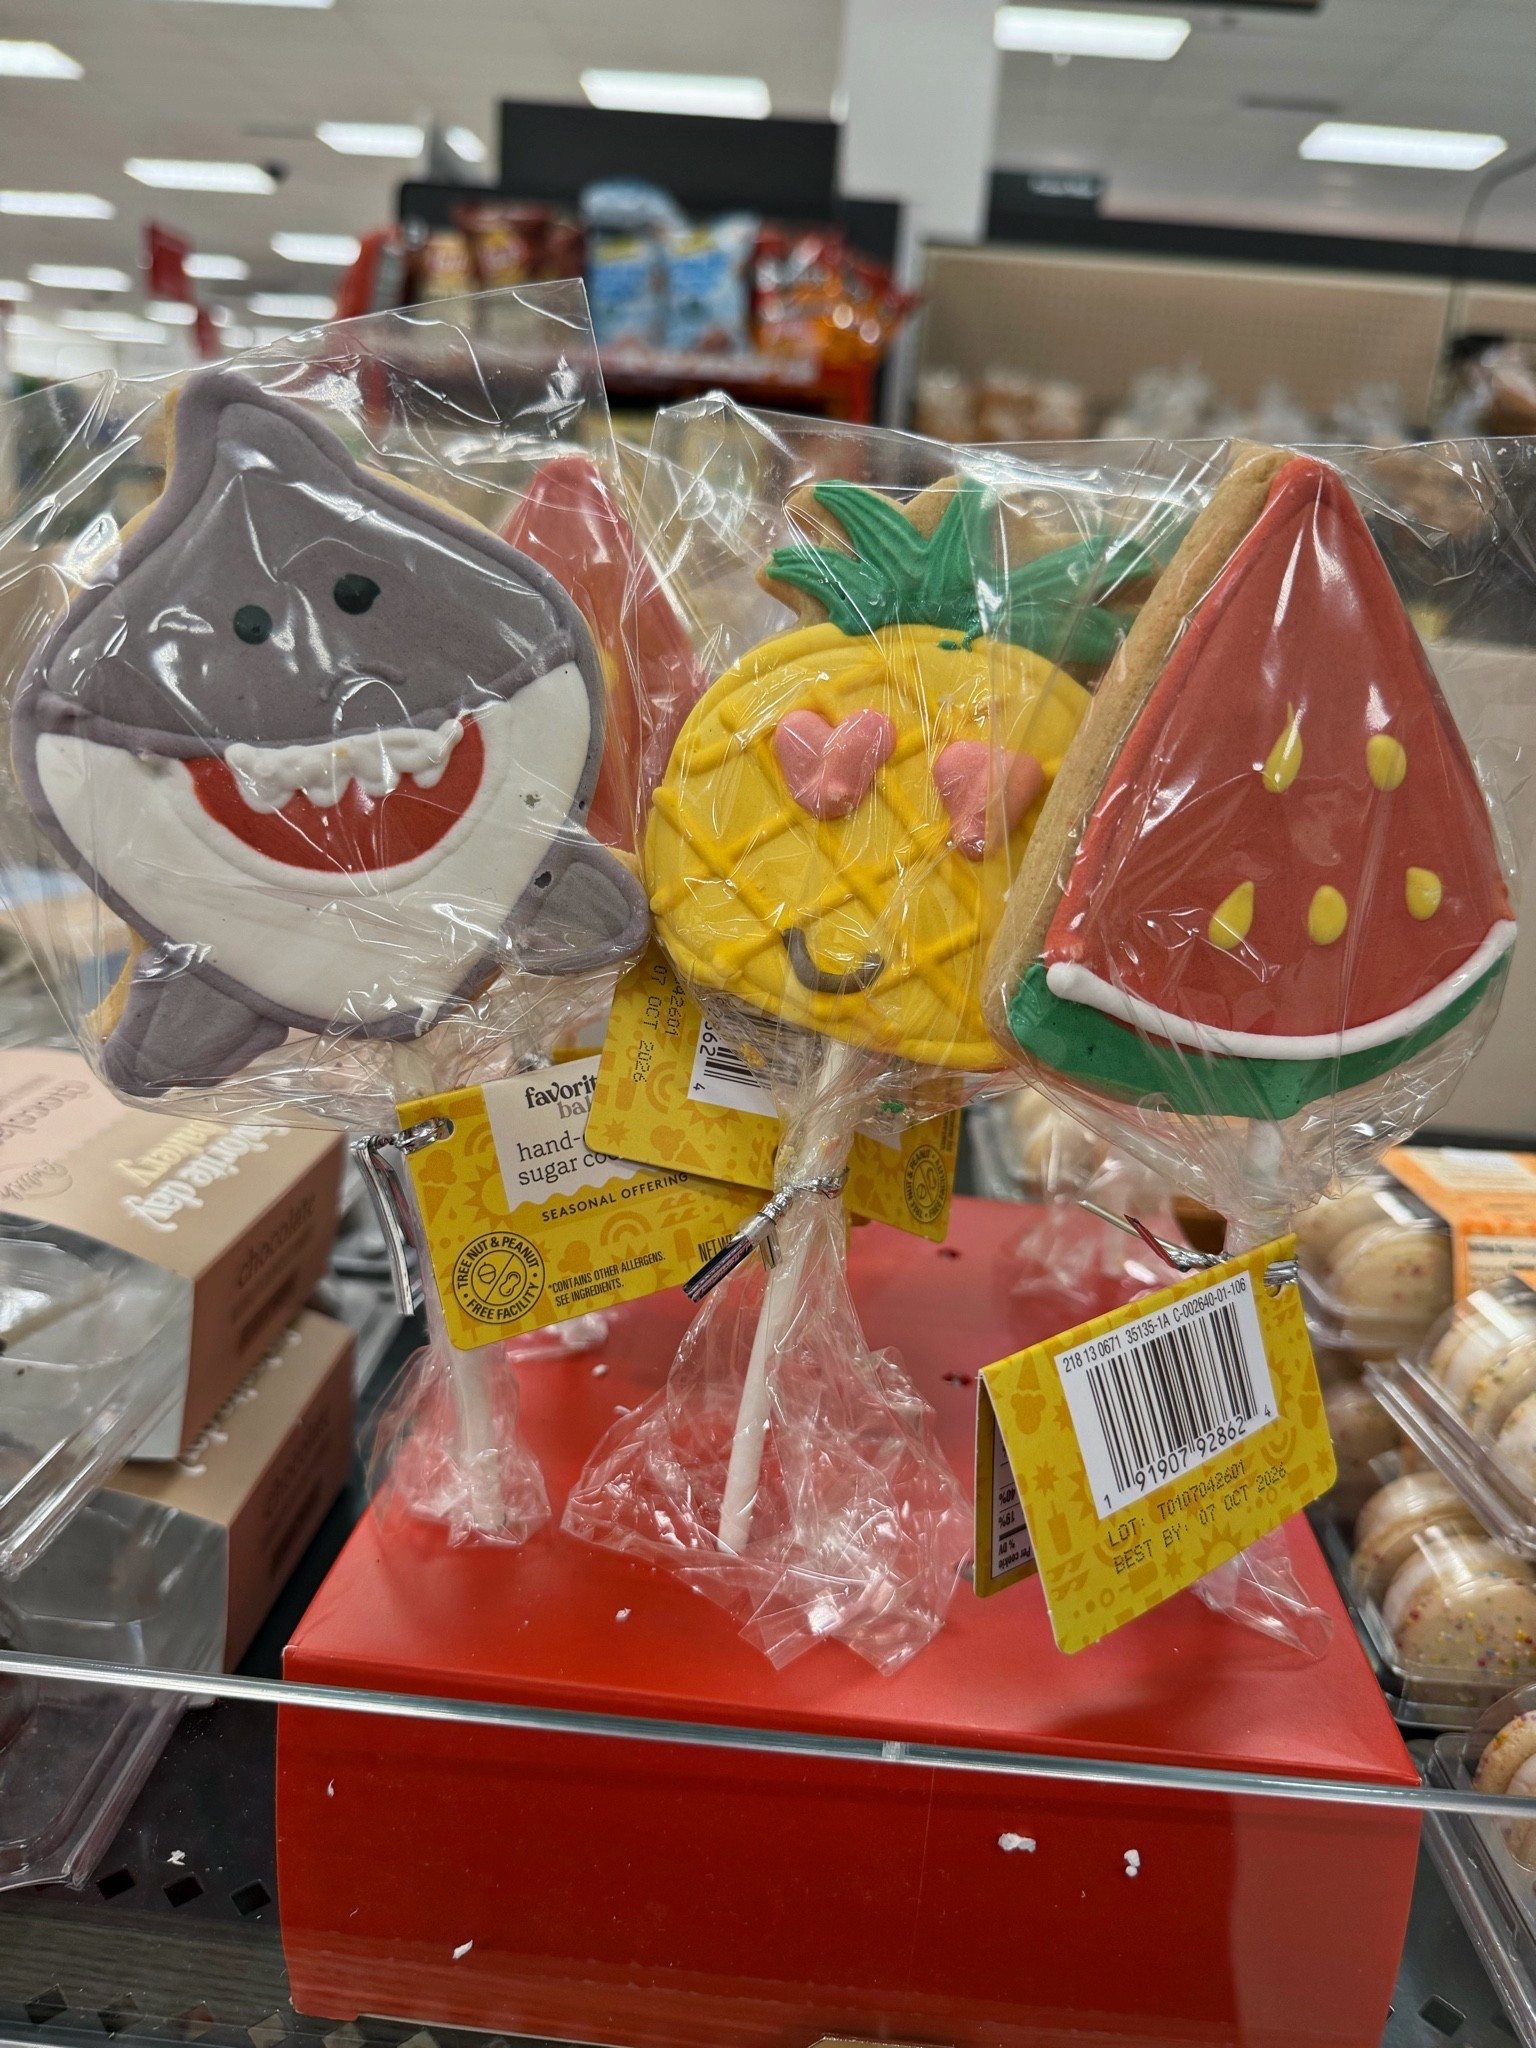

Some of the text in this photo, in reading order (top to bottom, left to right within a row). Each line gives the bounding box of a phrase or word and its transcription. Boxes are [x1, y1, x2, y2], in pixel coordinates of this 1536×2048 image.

[633, 965, 668, 1083] 07 OCT 2026
[524, 1074, 598, 1109] favorit
[693, 1082, 706, 1091] 4
[516, 1130, 586, 1162] hand-
[518, 1157, 578, 1186] sugar
[541, 1172, 688, 1222] SEASONAL OFFERING
[457, 1236, 540, 1290] TREE NUT & PEANUT
[594, 1265, 619, 1281] OTHER
[621, 1251, 666, 1273] ALLERGENS.
[698, 1239, 716, 1262] NET
[466, 1282, 539, 1320] FREE FACILITY
[555, 1278, 625, 1307] SEE INGREDIENTS.
[1062, 1278, 1246, 1373] 218 13 0671 35135-1A C-002640-01-106
[1103, 1404, 1271, 1509] 1 91907 92862 4
[1107, 1459, 1246, 1547] LOT: T0107042601
[1113, 1461, 1287, 1574] BEST BY: 07 OCT 2026
